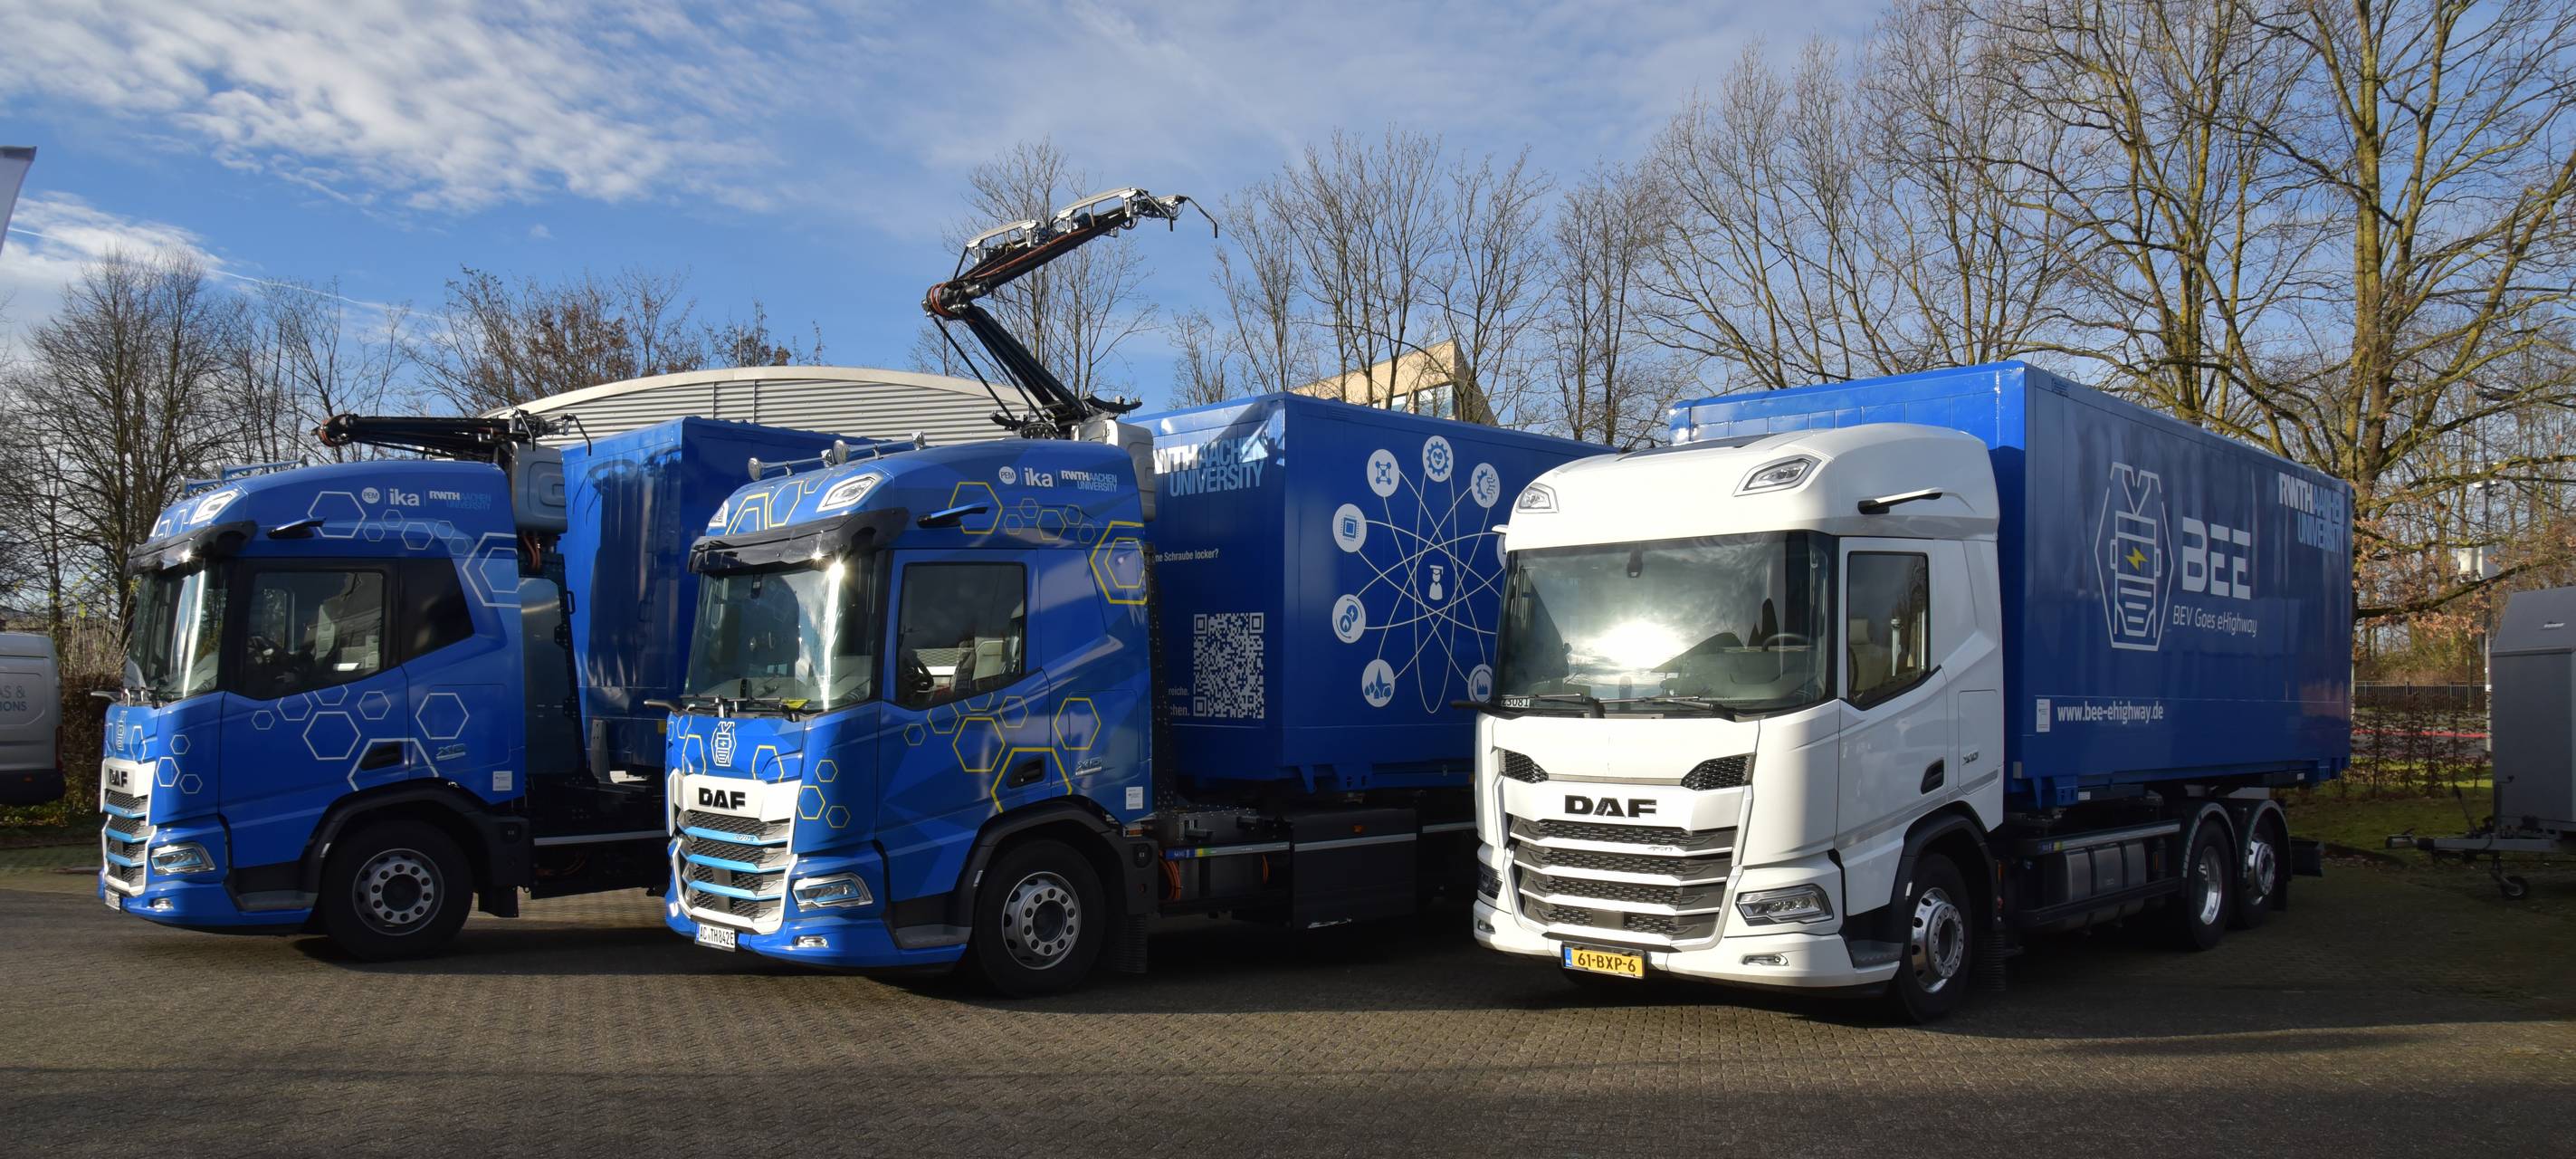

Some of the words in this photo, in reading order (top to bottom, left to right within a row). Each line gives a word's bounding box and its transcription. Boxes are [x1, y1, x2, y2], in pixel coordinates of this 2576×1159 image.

[1025, 467, 1054, 487] ika
[1077, 481, 1118, 493] UNIVERSITY
[1169, 461, 1264, 497] UNIVERSITY
[389, 488, 420, 506] ika
[2297, 512, 2345, 554] UNIVERSITY
[1164, 550, 1194, 561] Schraube
[1195, 548, 1219, 560] locker?
[2182, 516, 2251, 600] BEE
[2172, 605, 2193, 626] BEV
[2195, 608, 2216, 629] Goes
[2218, 611, 2258, 637] eHighway
[2056, 700, 2164, 724] www.bee-ehighway.de
[109, 768, 129, 788] DAF
[698, 787, 746, 810] DAF
[1564, 794, 1657, 819] DAF
[1578, 953, 1636, 972] 61-BXP-6
